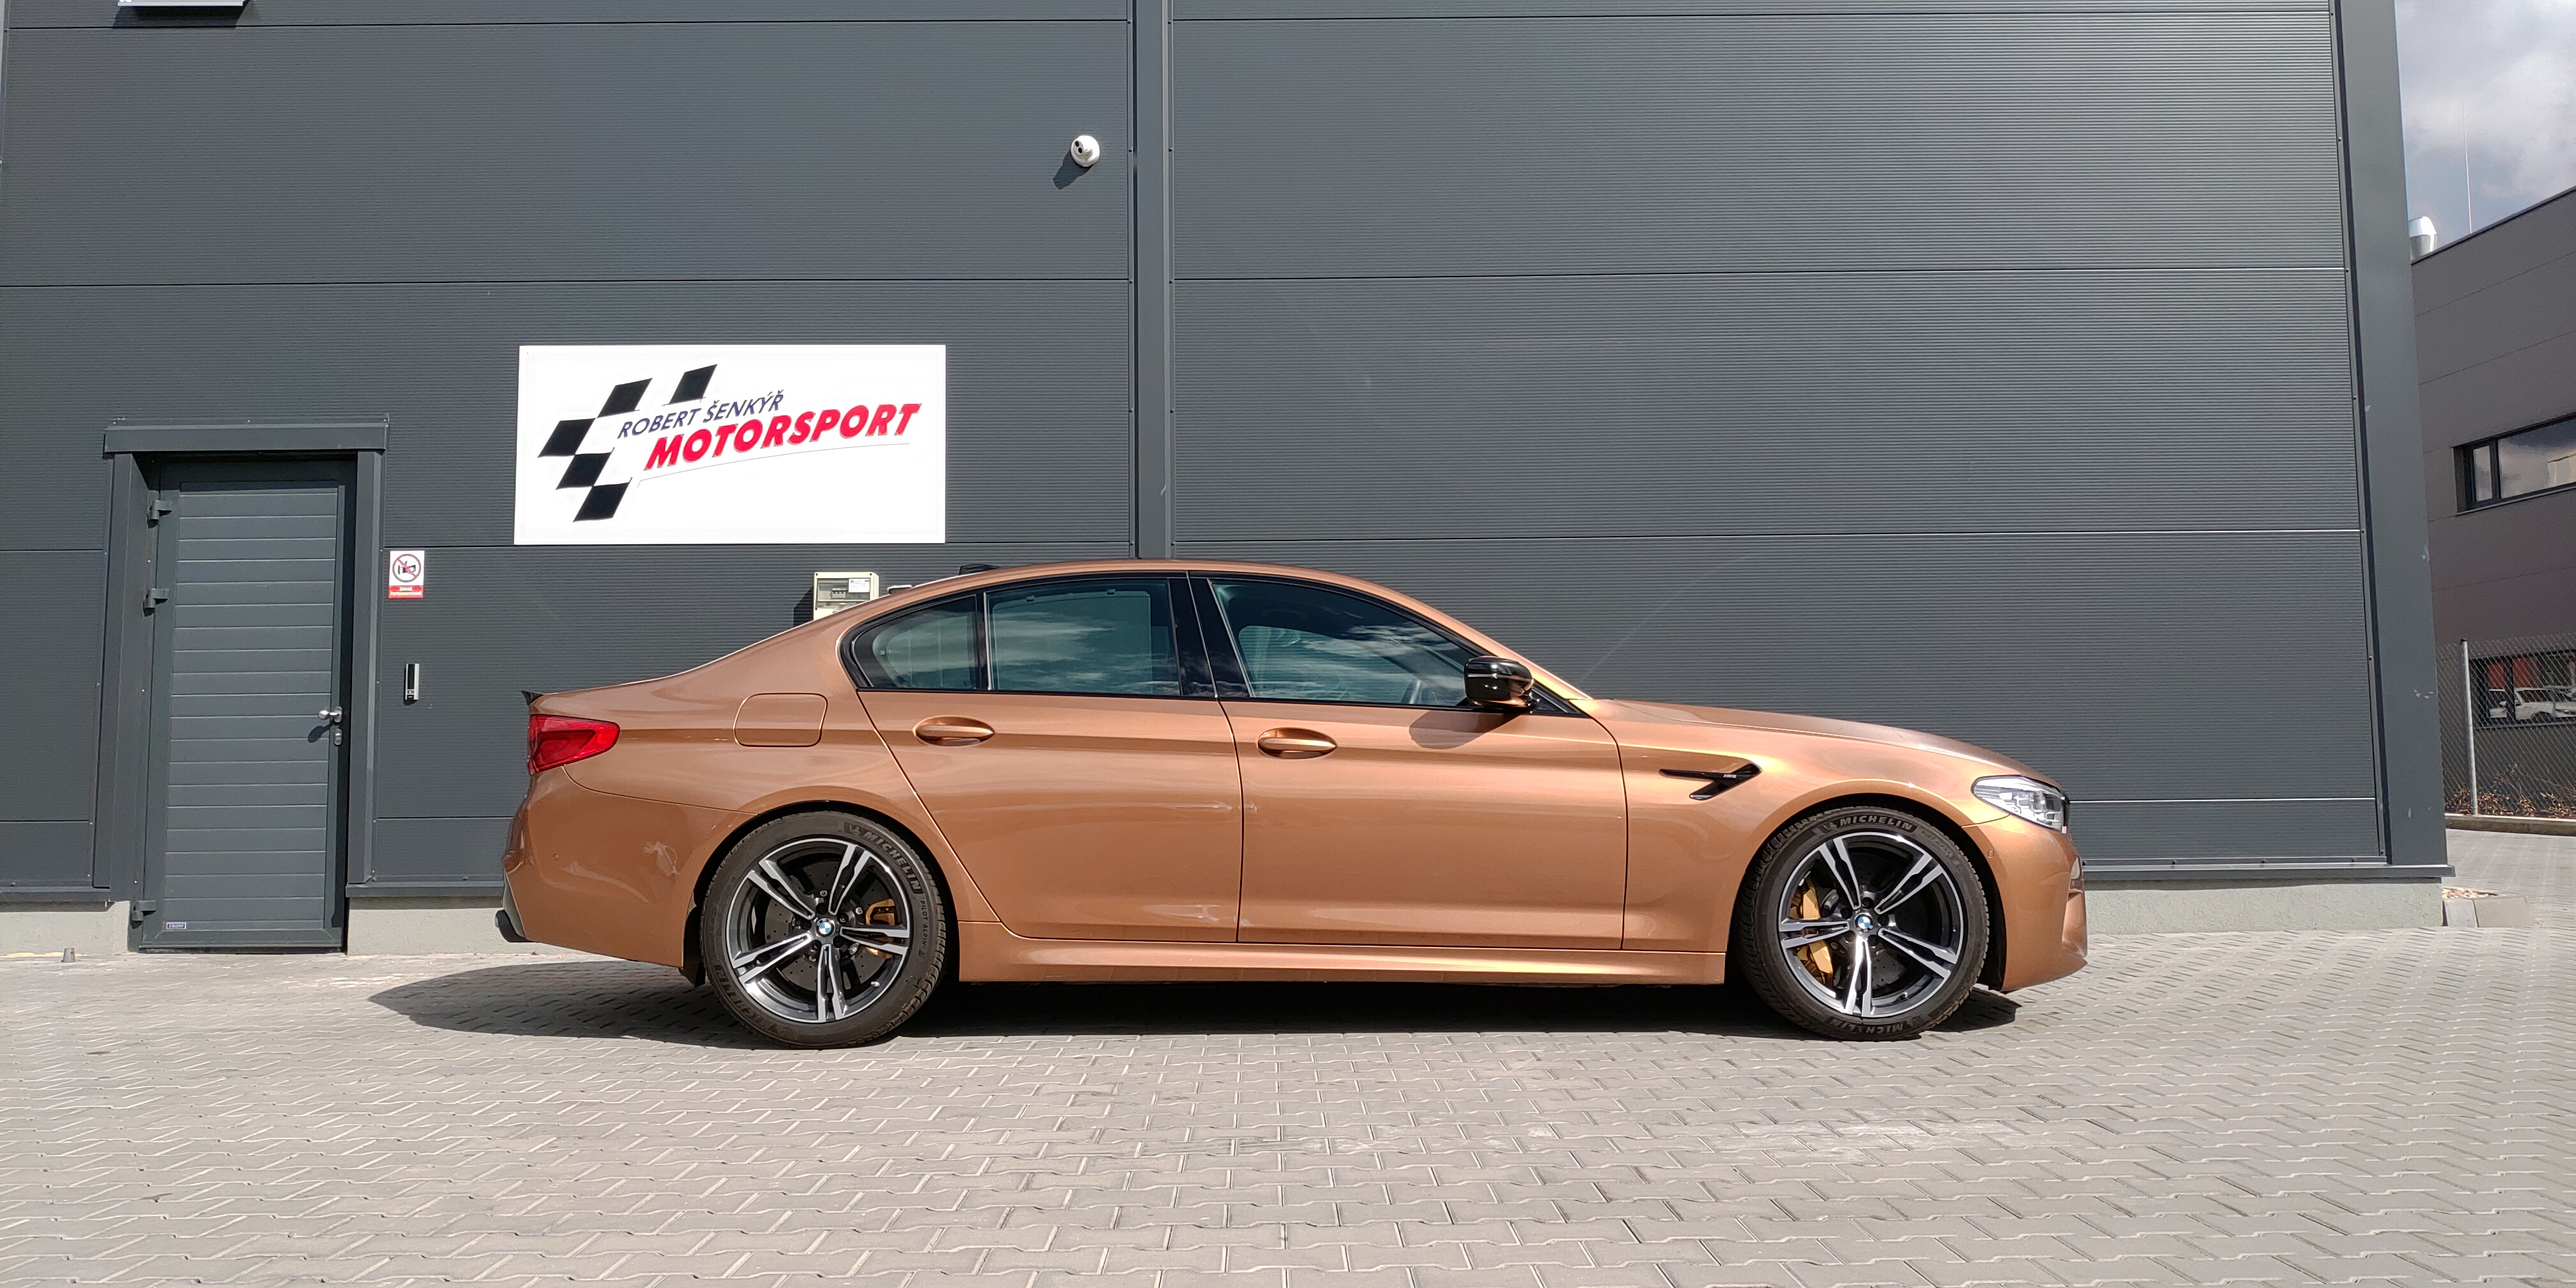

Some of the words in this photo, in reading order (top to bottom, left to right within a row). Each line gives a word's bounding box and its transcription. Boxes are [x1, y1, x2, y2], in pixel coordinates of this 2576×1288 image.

[617, 408, 702, 439] ROBERT
[703, 390, 784, 423] ŠENKÝŘ
[643, 403, 922, 471] MOTORSPORT
[1840, 815, 1913, 831] MICHELIN
[864, 831, 922, 891] MICHELIN
[919, 900, 929, 921] PILOT
[1829, 1018, 1903, 1034] MICHELIN
